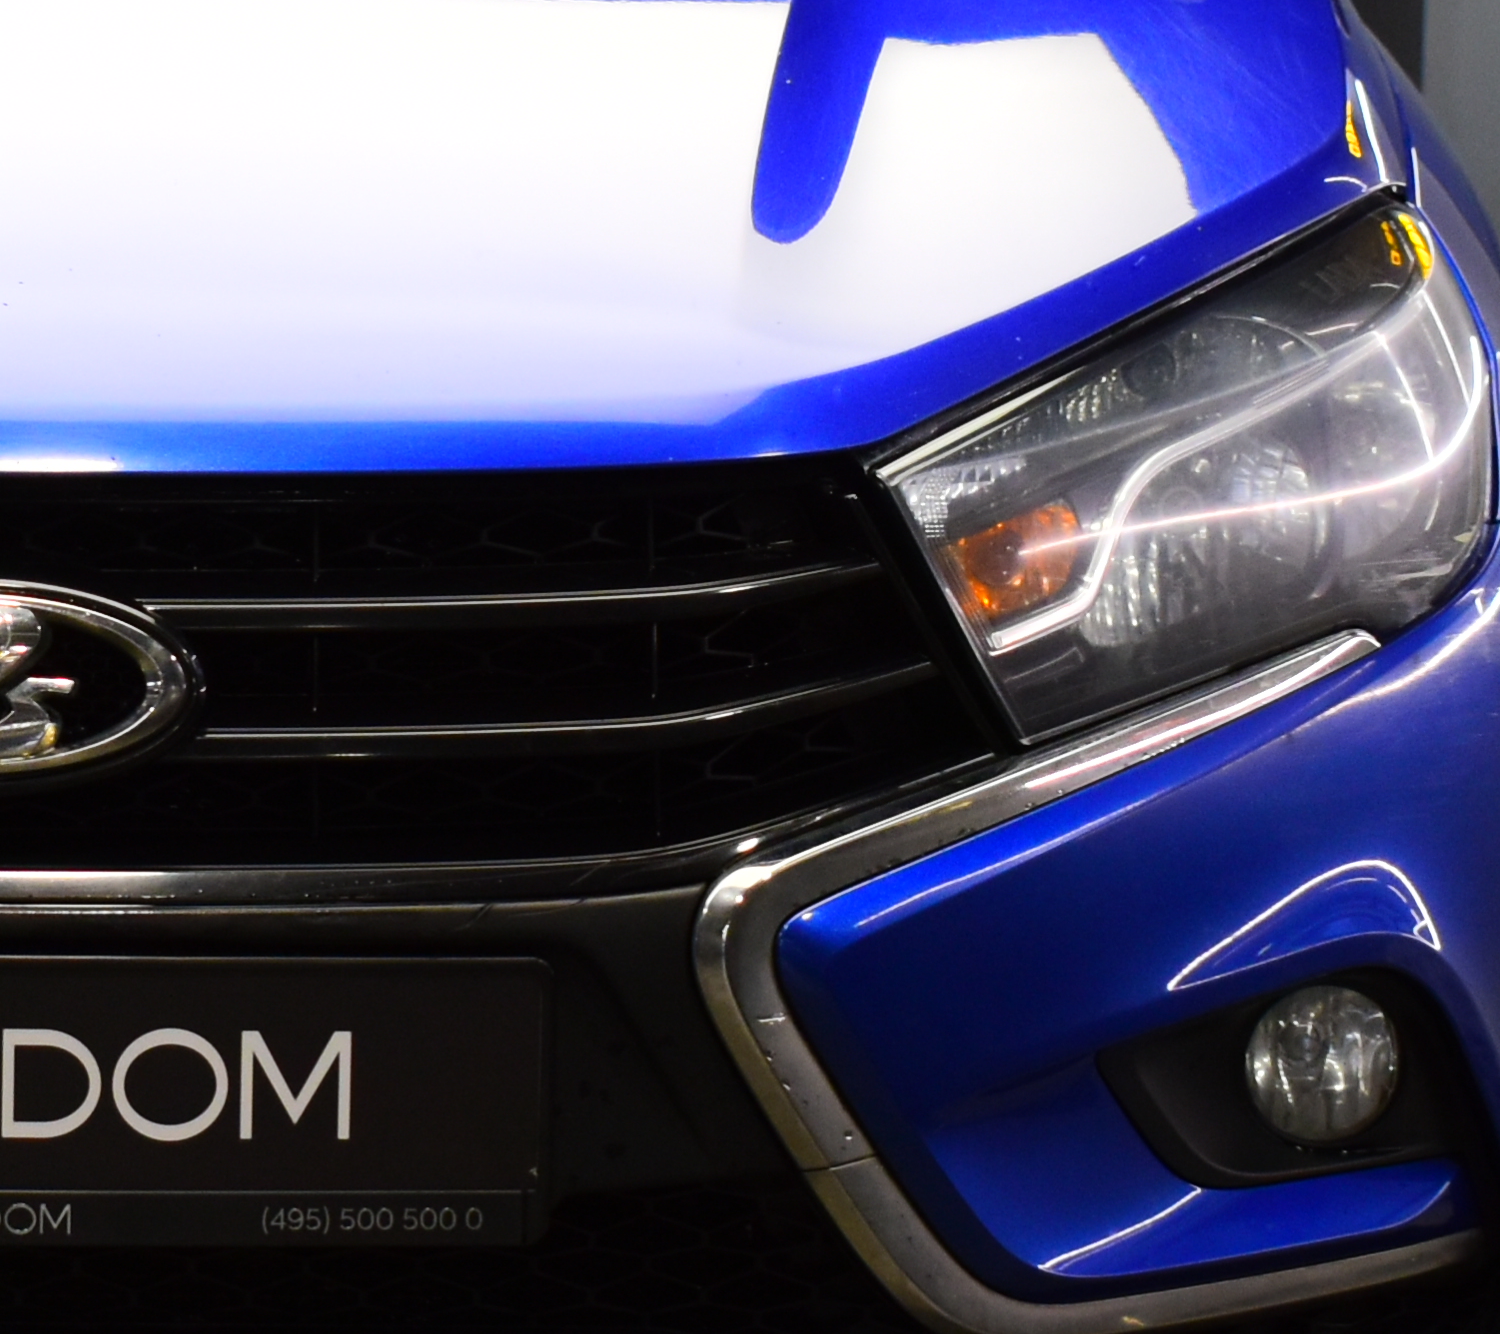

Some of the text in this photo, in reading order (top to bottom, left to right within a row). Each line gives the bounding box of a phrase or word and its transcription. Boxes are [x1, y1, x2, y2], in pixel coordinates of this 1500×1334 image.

[261, 1205, 483, 1235] (495) 500 500 0
